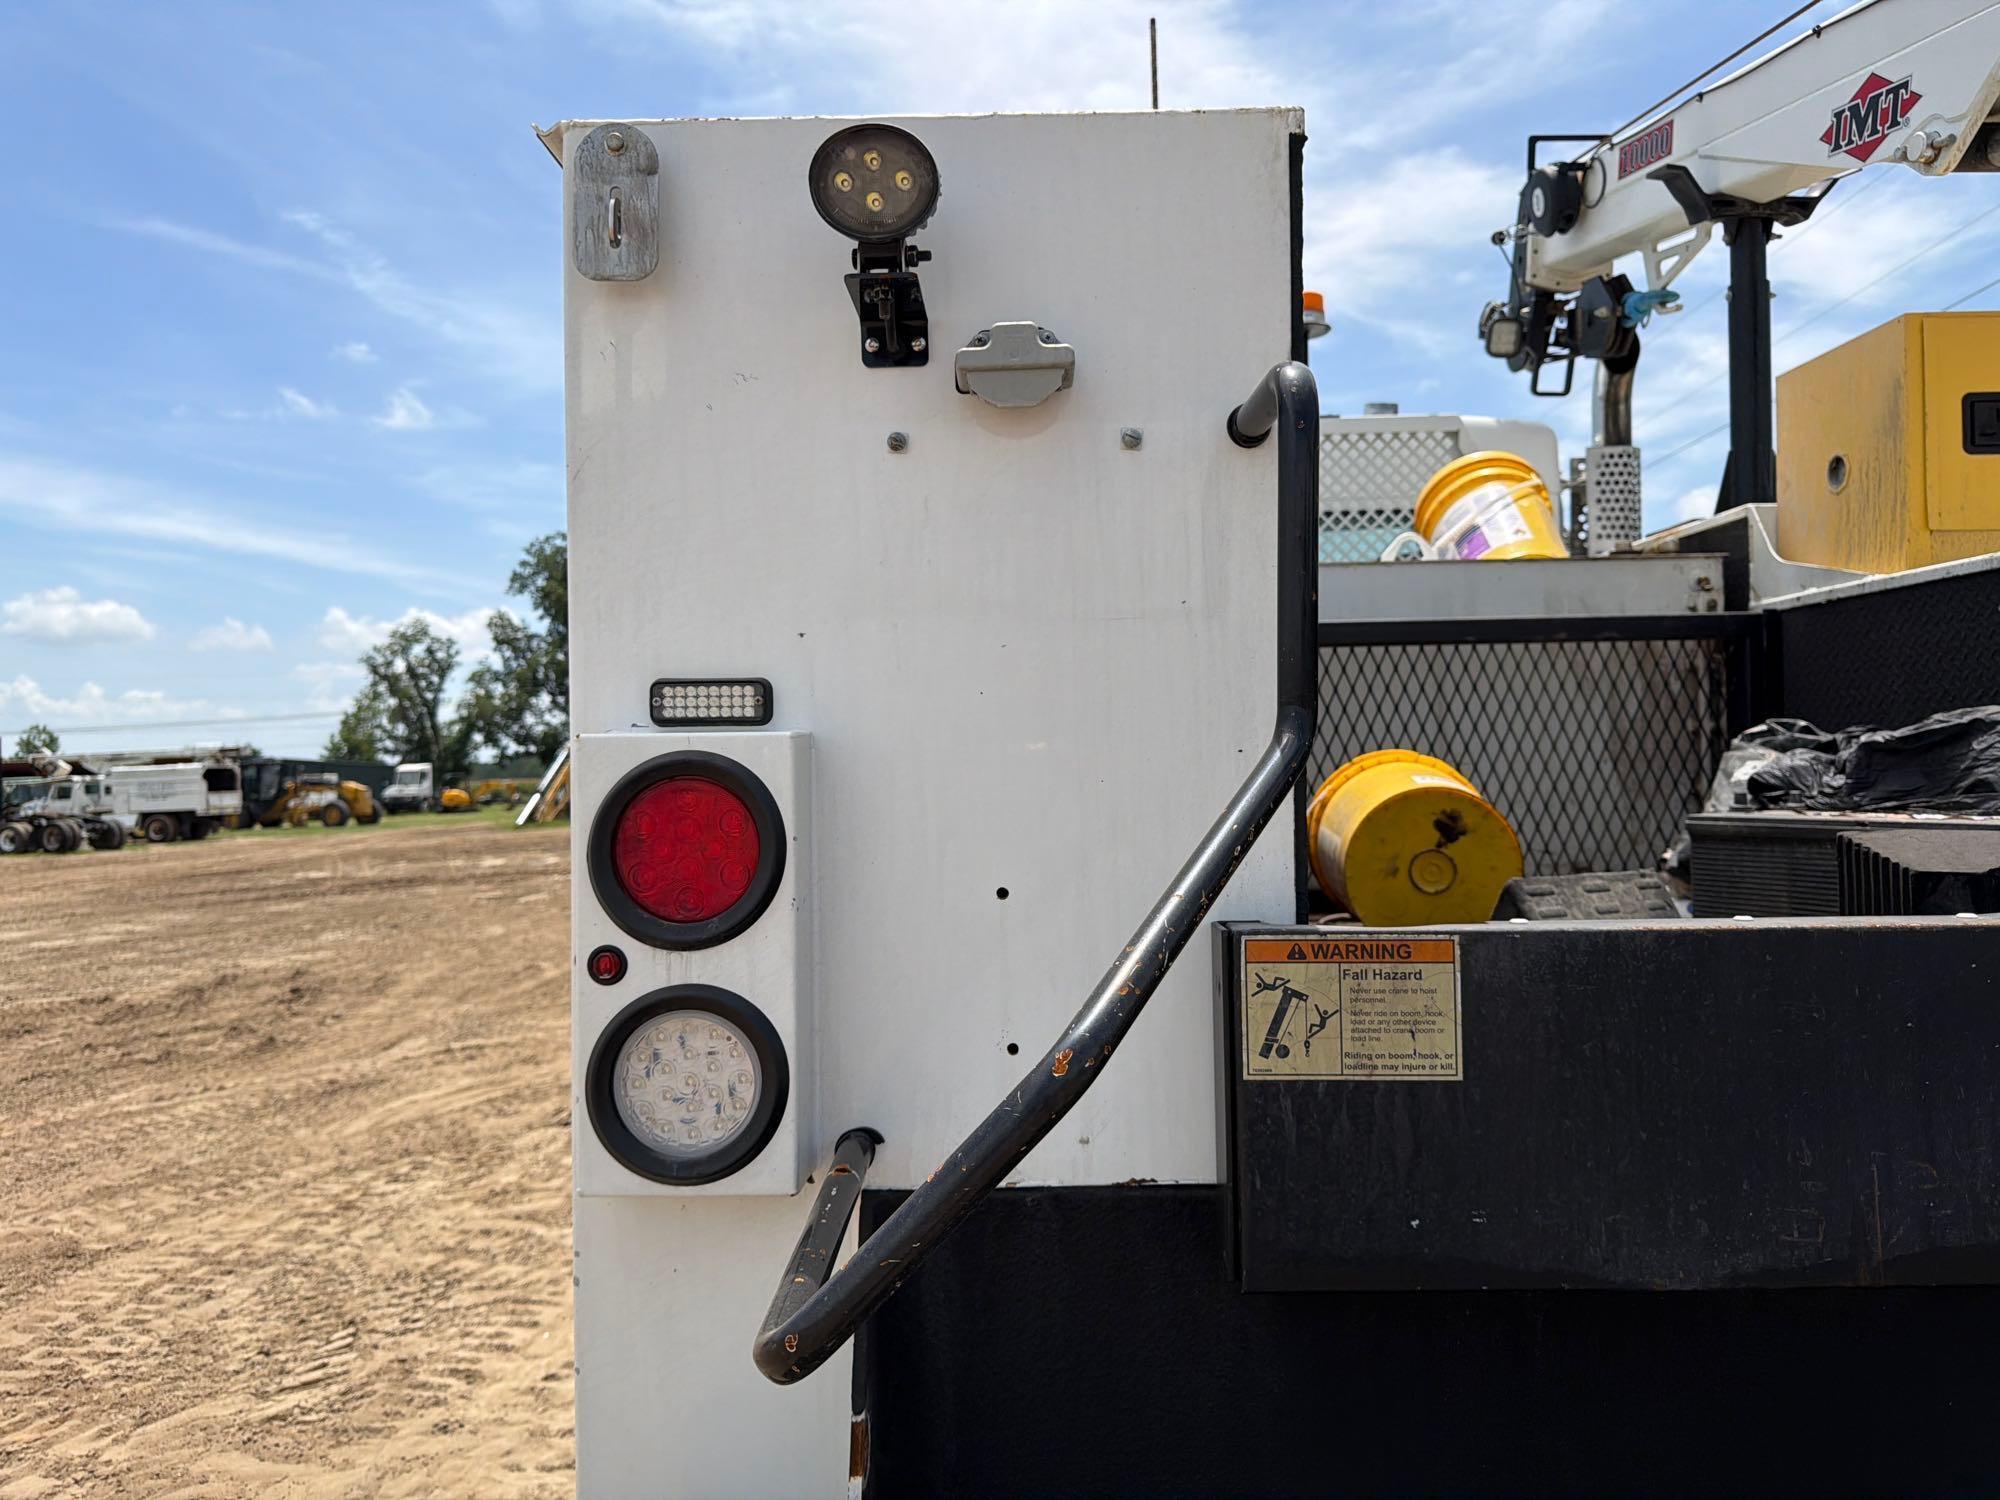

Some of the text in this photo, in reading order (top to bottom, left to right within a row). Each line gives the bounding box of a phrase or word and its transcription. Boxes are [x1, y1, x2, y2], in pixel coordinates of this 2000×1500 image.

[1310, 943, 1413, 960] WARNING
[1342, 968, 1423, 981] Fall Hazard
[1349, 987, 1372, 995] Never
[1410, 987, 1418, 995] to
[1419, 987, 1438, 995] hoist
[1350, 1010, 1372, 1018] Never
[1373, 1010, 1387, 1018] ride
[1350, 1018, 1366, 1026] load
[1392, 1018, 1411, 1026] other
[1412, 1018, 1437, 1026] device
[1344, 1051, 1373, 1061] Riding
[1388, 1051, 1416, 1061] boom,
[1417, 1051, 1442, 1061] hook,
[1344, 1062, 1379, 1071] loadline
[1381, 1064, 1400, 1073] may
[1401, 1062, 1426, 1072] injure
[1440, 1062, 1456, 1071] kill.
